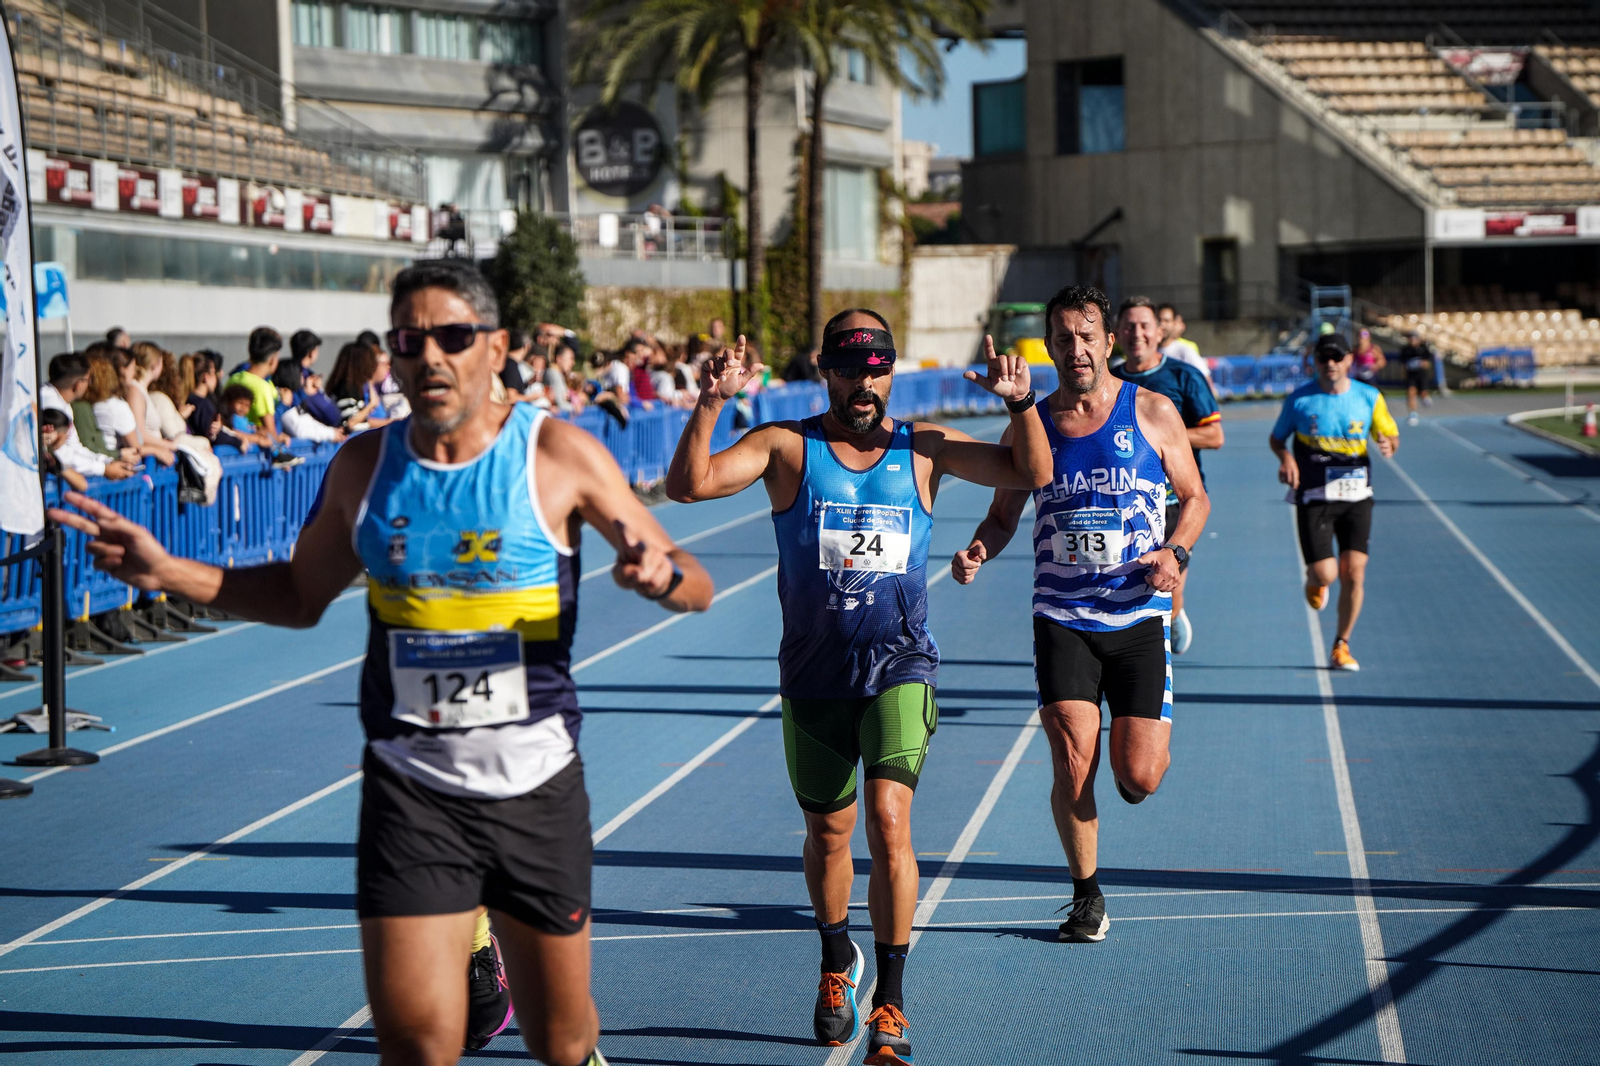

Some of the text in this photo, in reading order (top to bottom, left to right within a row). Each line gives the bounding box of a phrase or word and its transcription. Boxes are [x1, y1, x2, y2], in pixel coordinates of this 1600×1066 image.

[843, 516, 866, 524] Ciudad
[850, 532, 883, 556] 24
[1065, 532, 1106, 552] 313
[423, 671, 493, 704] 124
